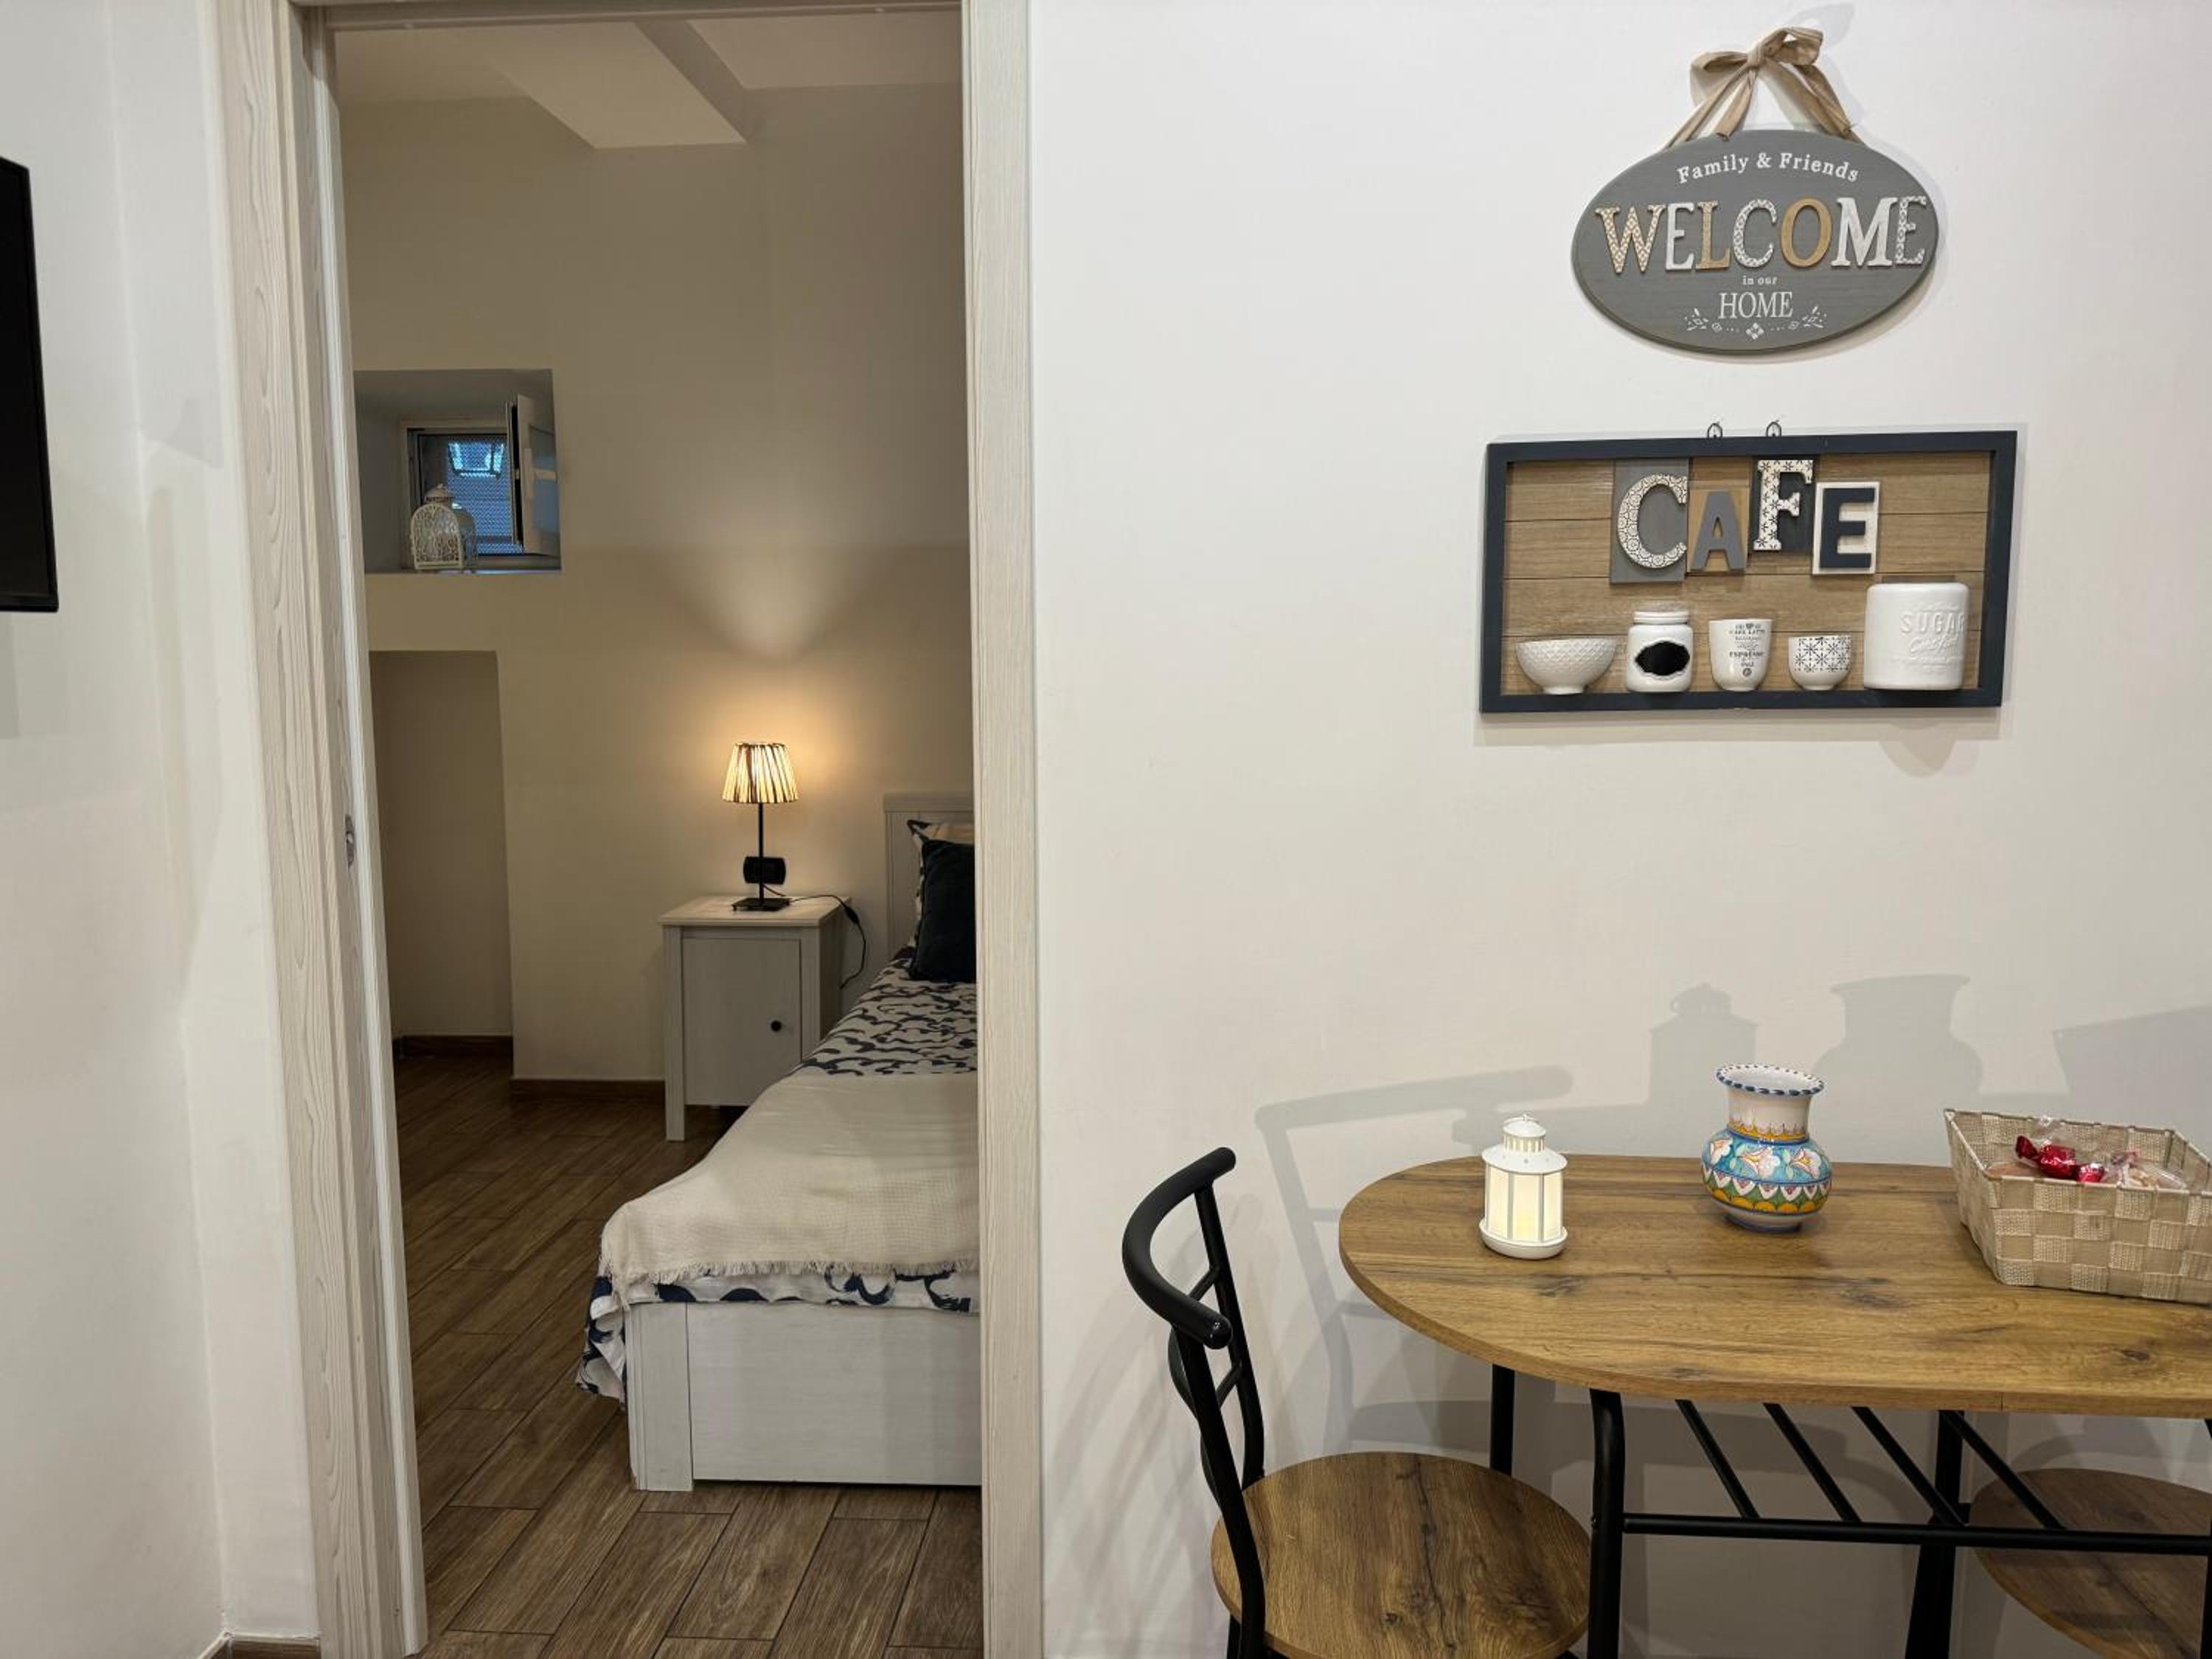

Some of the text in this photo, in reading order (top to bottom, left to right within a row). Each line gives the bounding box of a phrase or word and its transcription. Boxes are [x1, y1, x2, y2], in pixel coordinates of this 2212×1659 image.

[1676, 152, 1860, 184] Family & Friends
[1594, 196, 1927, 274] WELCOME
[1742, 275, 1778, 286] in our
[1717, 291, 1794, 319] HOME
[1617, 459, 1875, 572] CAFE
